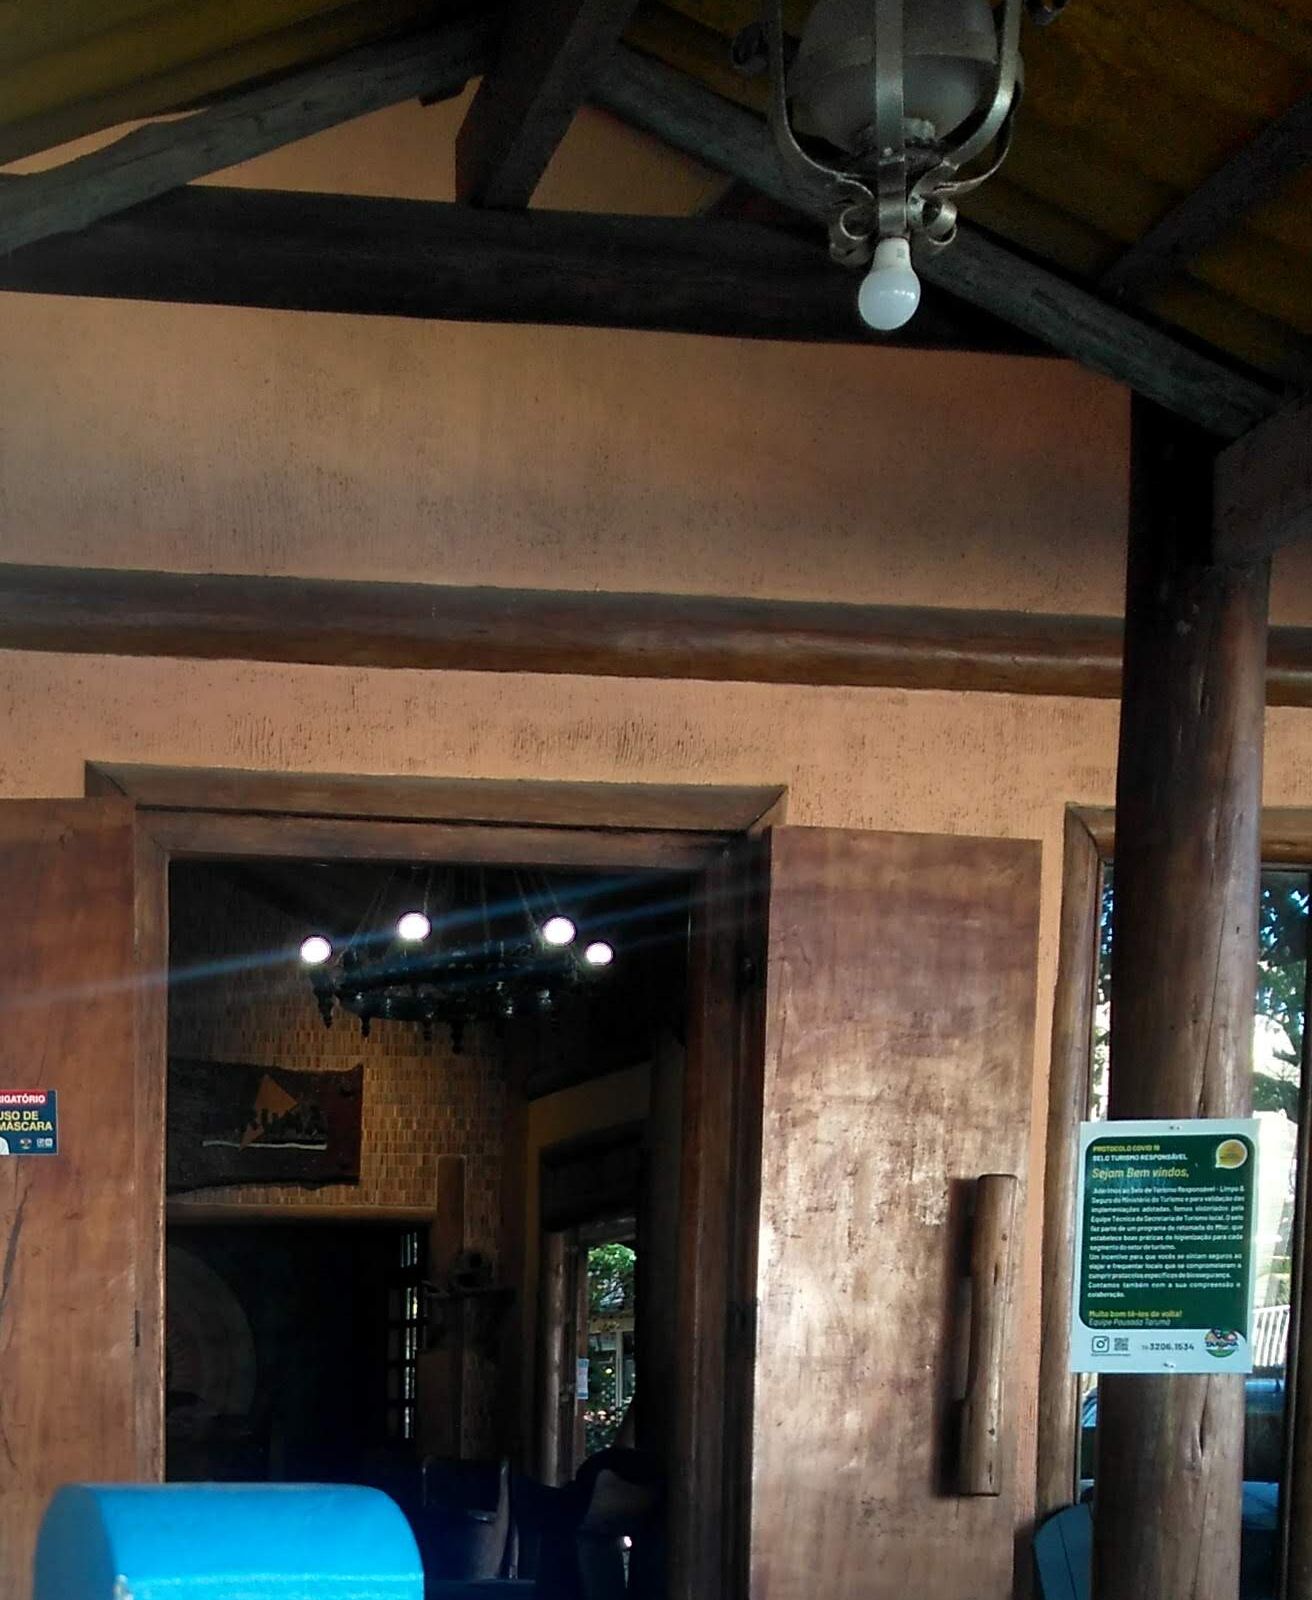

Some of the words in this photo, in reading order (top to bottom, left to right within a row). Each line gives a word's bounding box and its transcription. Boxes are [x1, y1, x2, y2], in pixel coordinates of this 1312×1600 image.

[23, 1110, 39, 1121] DE
[1092, 1168, 1124, 1180] Sejam
[1127, 1167, 1150, 1178] Bem
[1150, 1310, 1160, 1318] de
[1088, 1318, 1112, 1327] Equipe
[1114, 1318, 1144, 1326] Pousada
